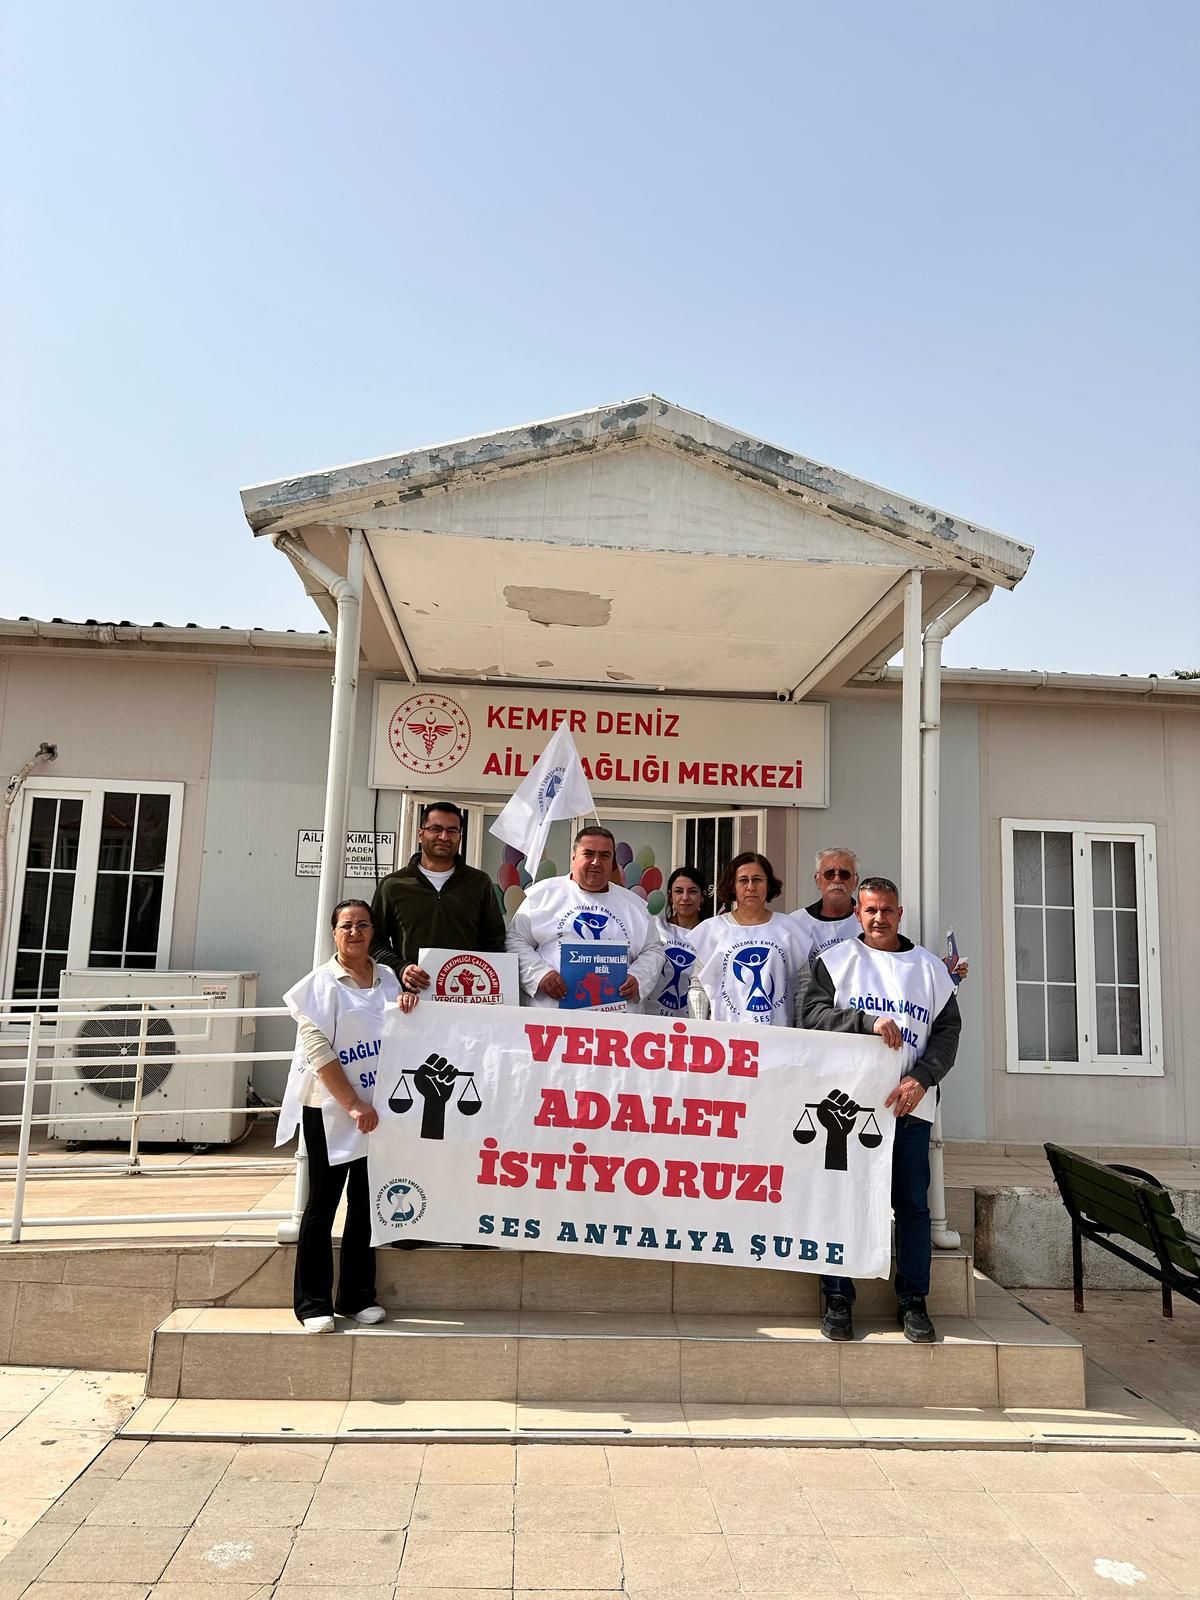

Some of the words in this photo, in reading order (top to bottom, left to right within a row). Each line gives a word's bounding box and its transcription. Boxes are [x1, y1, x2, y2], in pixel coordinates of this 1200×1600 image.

[486, 704, 587, 733] KEMER
[596, 707, 680, 738] DENİZ
[581, 751, 670, 784] AĞLIĞI
[678, 760, 803, 789] MERKEZİ
[469, 995, 500, 1004] ADALET
[751, 1003, 769, 1011] 1996
[848, 992, 897, 1013] SAĞLIK
[753, 1014, 770, 1023] SES
[522, 1021, 760, 1079] VERGİDE
[533, 1087, 747, 1139] ADALET
[476, 1136, 786, 1204] İSTİYORUZ!
[478, 1214, 541, 1239] SES
[556, 1220, 734, 1254] ANTALYA
[750, 1234, 844, 1265] ŞUBE
